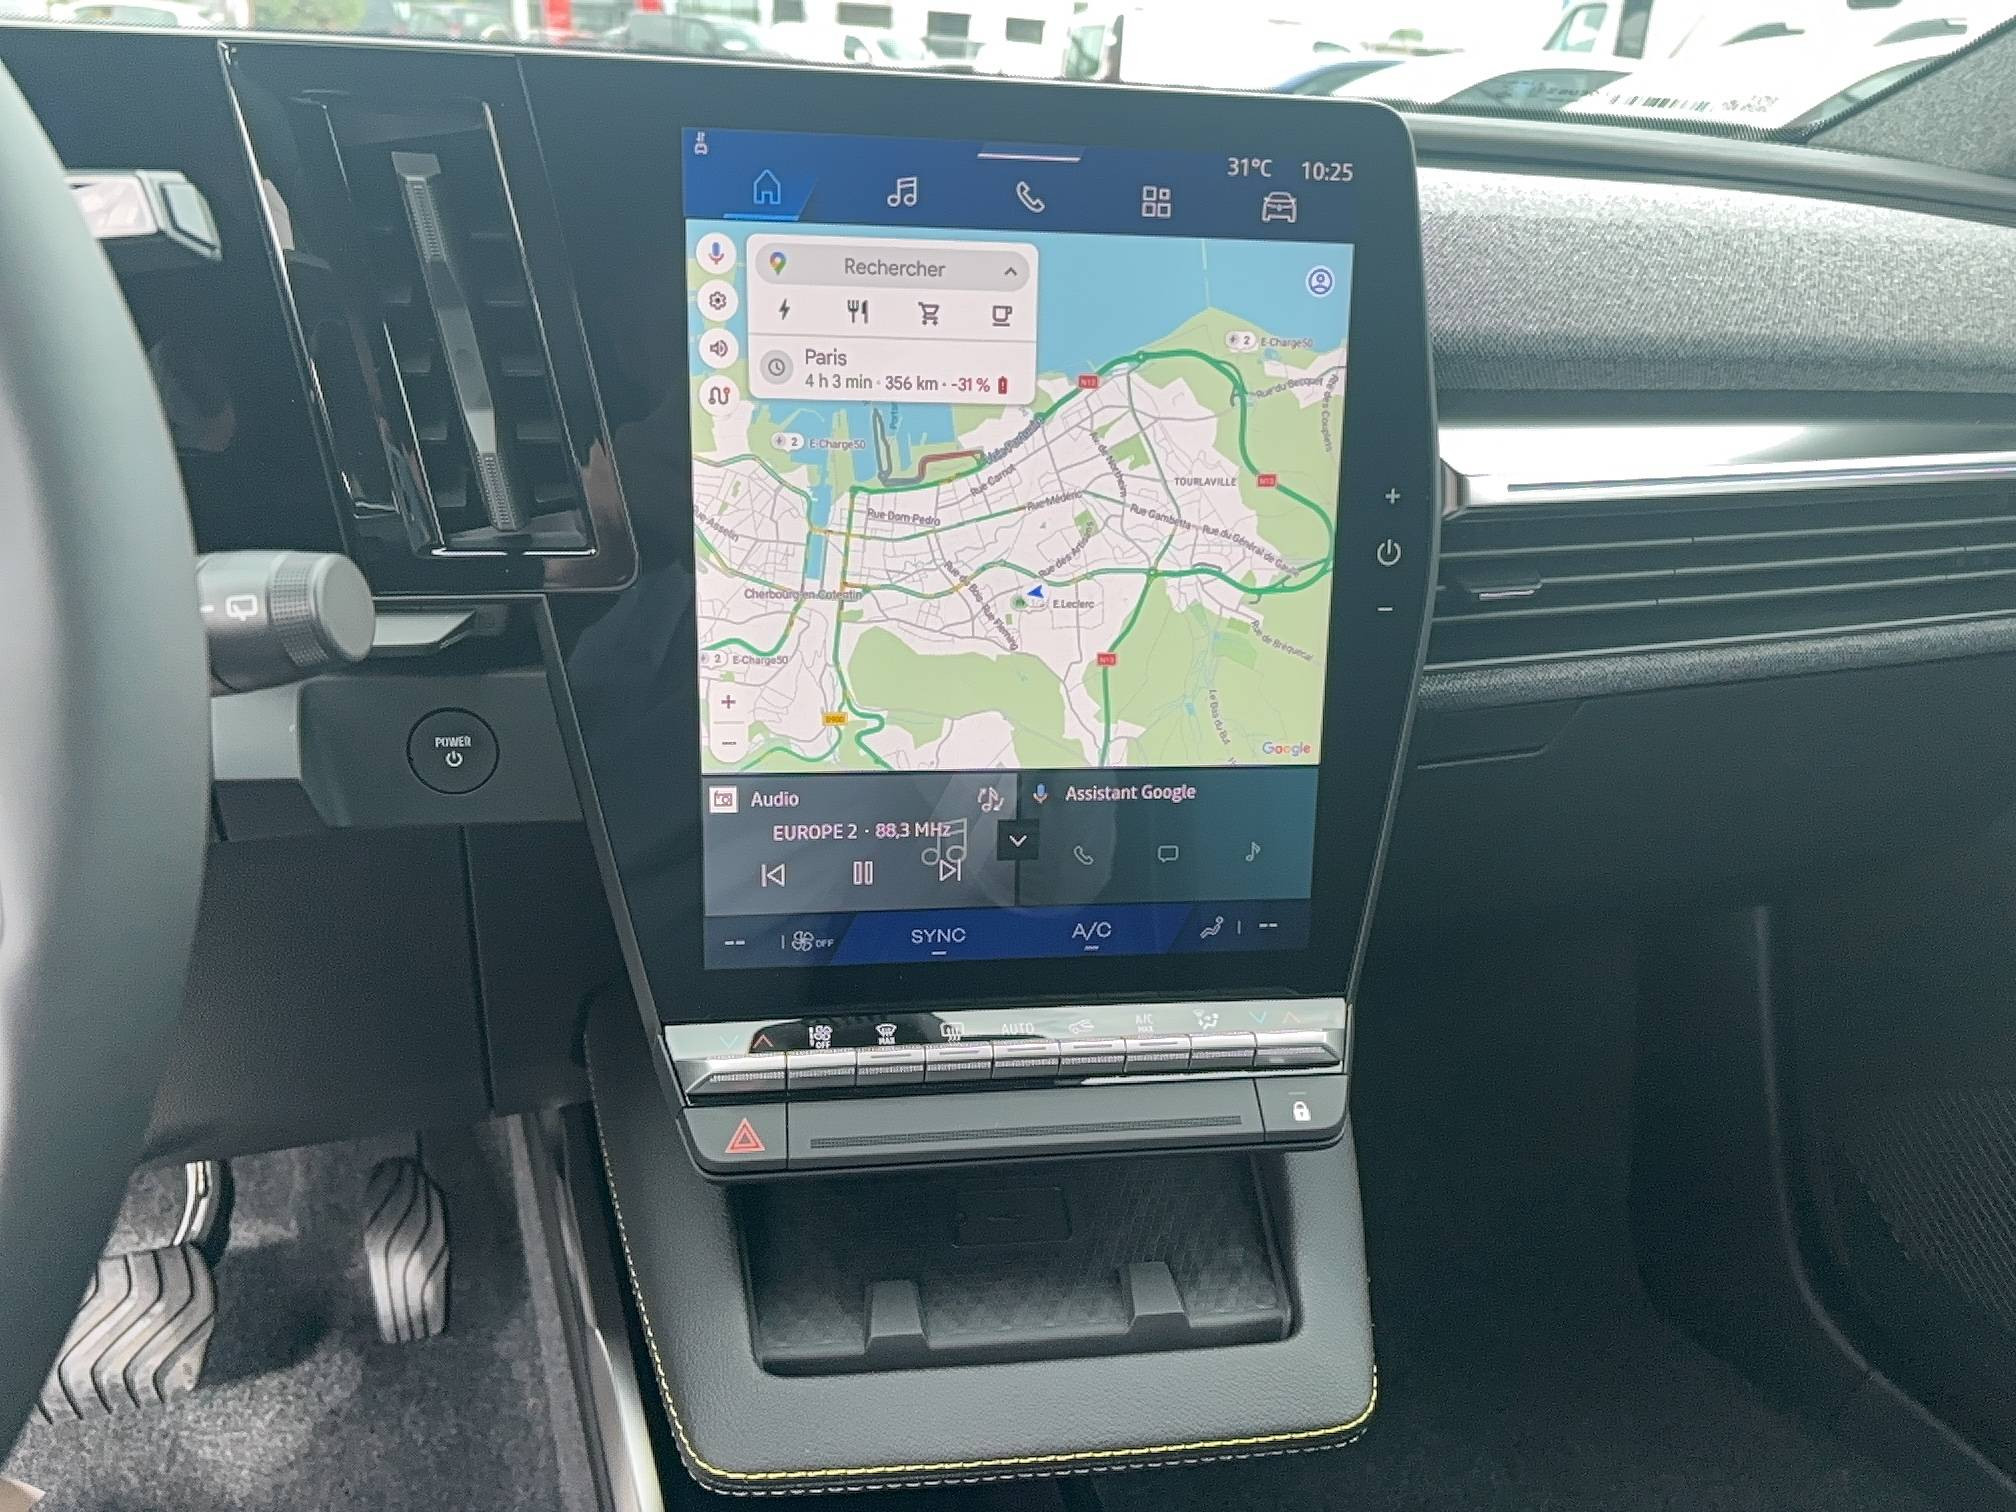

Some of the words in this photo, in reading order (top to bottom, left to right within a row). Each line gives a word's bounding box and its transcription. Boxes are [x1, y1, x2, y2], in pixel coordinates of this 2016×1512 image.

[1227, 157, 1272, 177] 31°C
[1302, 161, 1353, 181] 10:25
[844, 257, 946, 278] Rechercher
[805, 348, 847, 367] Paris
[805, 374, 814, 387] 4
[818, 374, 829, 388] h
[832, 375, 842, 388] 3
[845, 374, 873, 389] min
[885, 376, 912, 391] 356
[916, 375, 939, 391] km
[951, 377, 973, 392] -31
[976, 378, 991, 392] %
[971, 482, 988, 497] Rue
[988, 463, 1017, 486] Carnot
[1174, 477, 1237, 487] TOURLAVILLE
[867, 508, 886, 520] Rue
[912, 513, 941, 526] Pedro
[1130, 503, 1146, 516] Rue
[1148, 509, 1192, 530] Gambetta
[1052, 600, 1095, 609] E.Leclerc
[434, 735, 472, 748] POWER
[1263, 741, 1311, 757] Google
[750, 790, 800, 808] Audio
[1065, 785, 1138, 802] Assistant
[1140, 783, 1197, 803] Google
[772, 823, 843, 842] EUROPE
[847, 823, 858, 840] 2
[875, 822, 911, 839] 88,3
[915, 821, 952, 838] MHz
[911, 928, 967, 944] SYNC
[1072, 921, 1112, 941] A/C
[815, 938, 835, 949] OFF
[1001, 1022, 1035, 1036] AUTO
[815, 1040, 831, 1049] OFF
